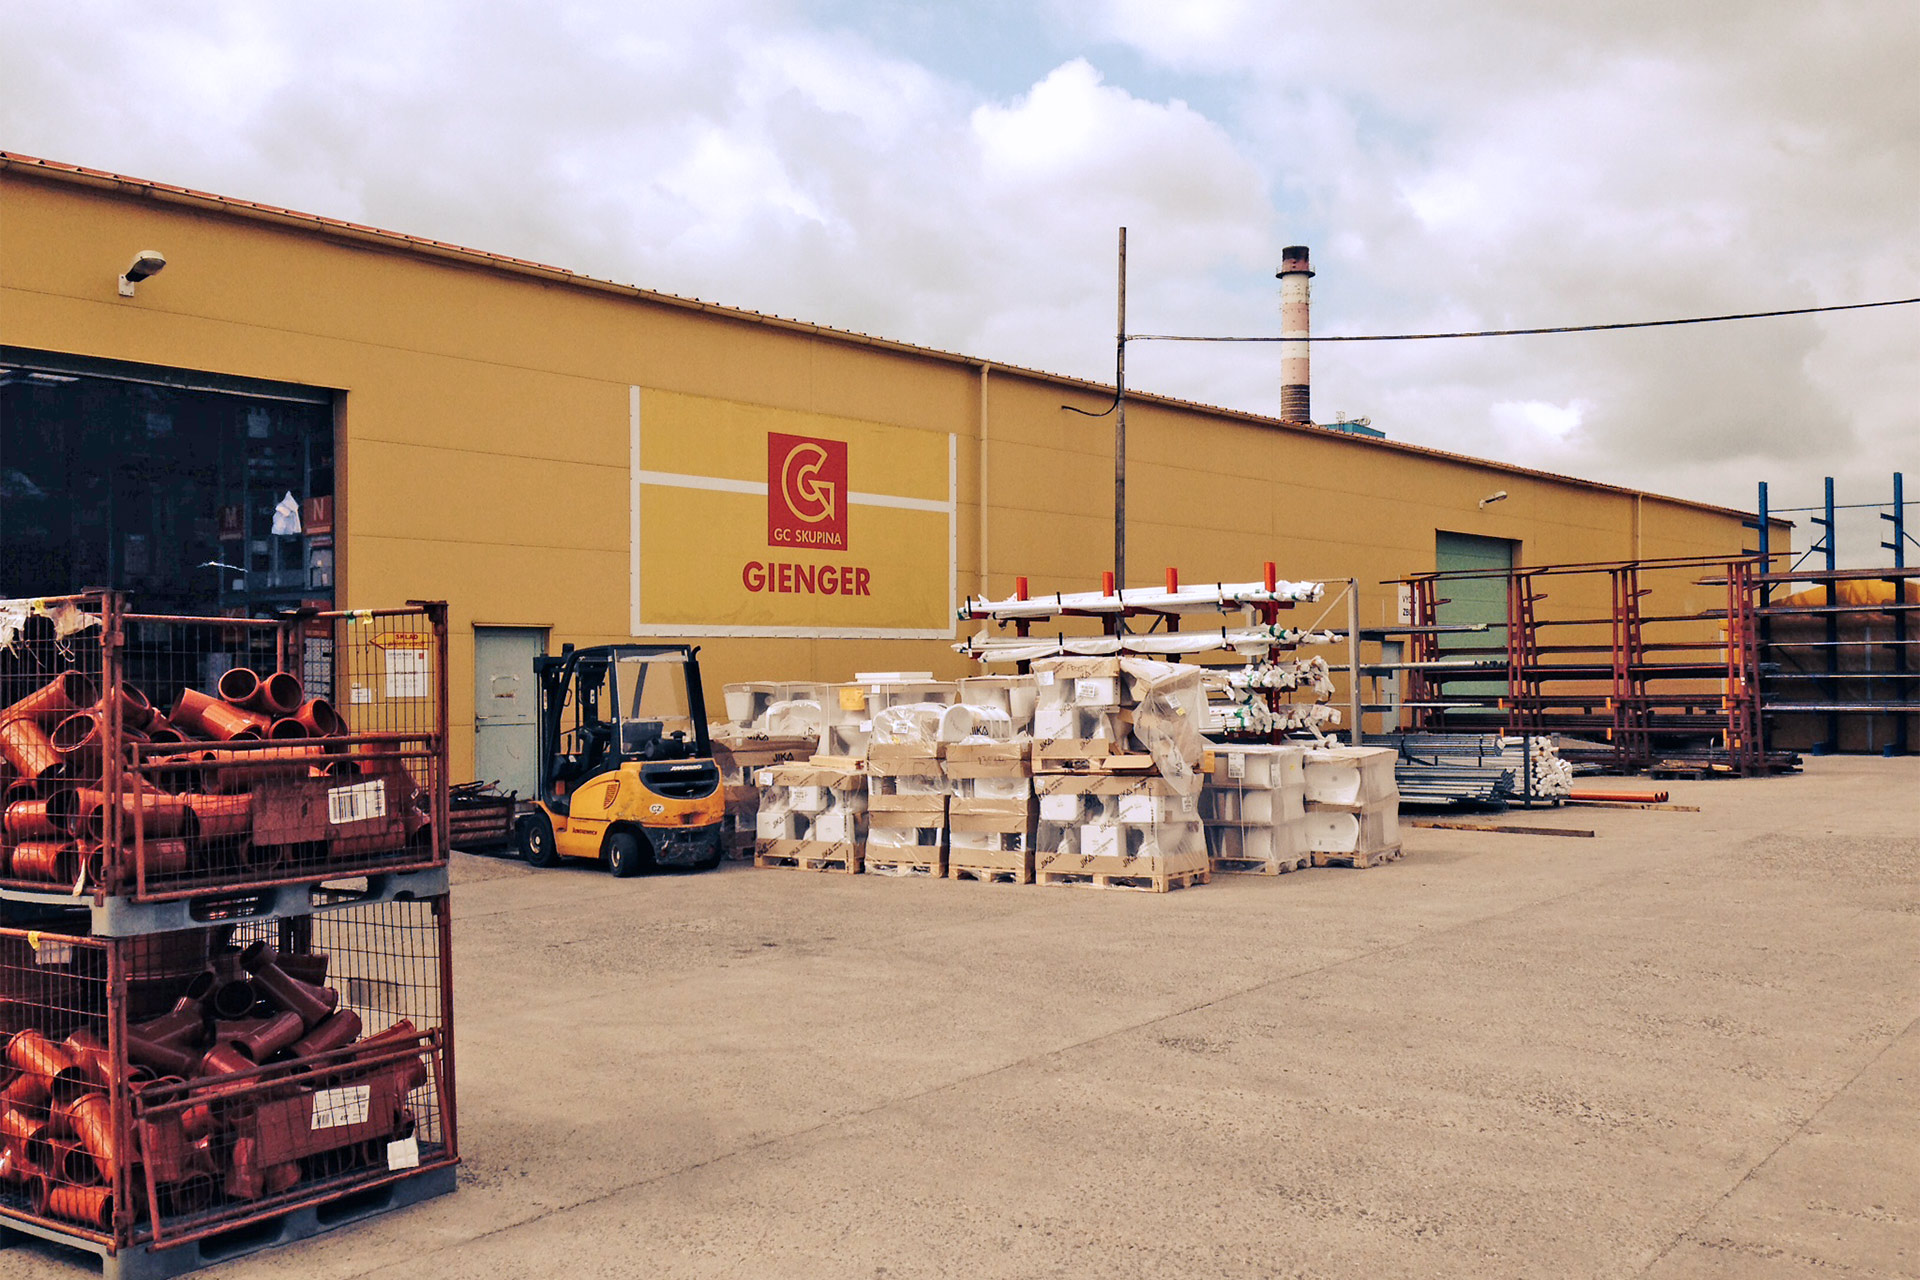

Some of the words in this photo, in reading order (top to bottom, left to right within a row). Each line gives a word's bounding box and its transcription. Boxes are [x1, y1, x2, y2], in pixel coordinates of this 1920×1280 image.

[774, 528, 791, 542] GC
[795, 529, 842, 545] SKUPINA
[742, 561, 871, 596] GIENGER
[773, 752, 795, 763] JIKA
